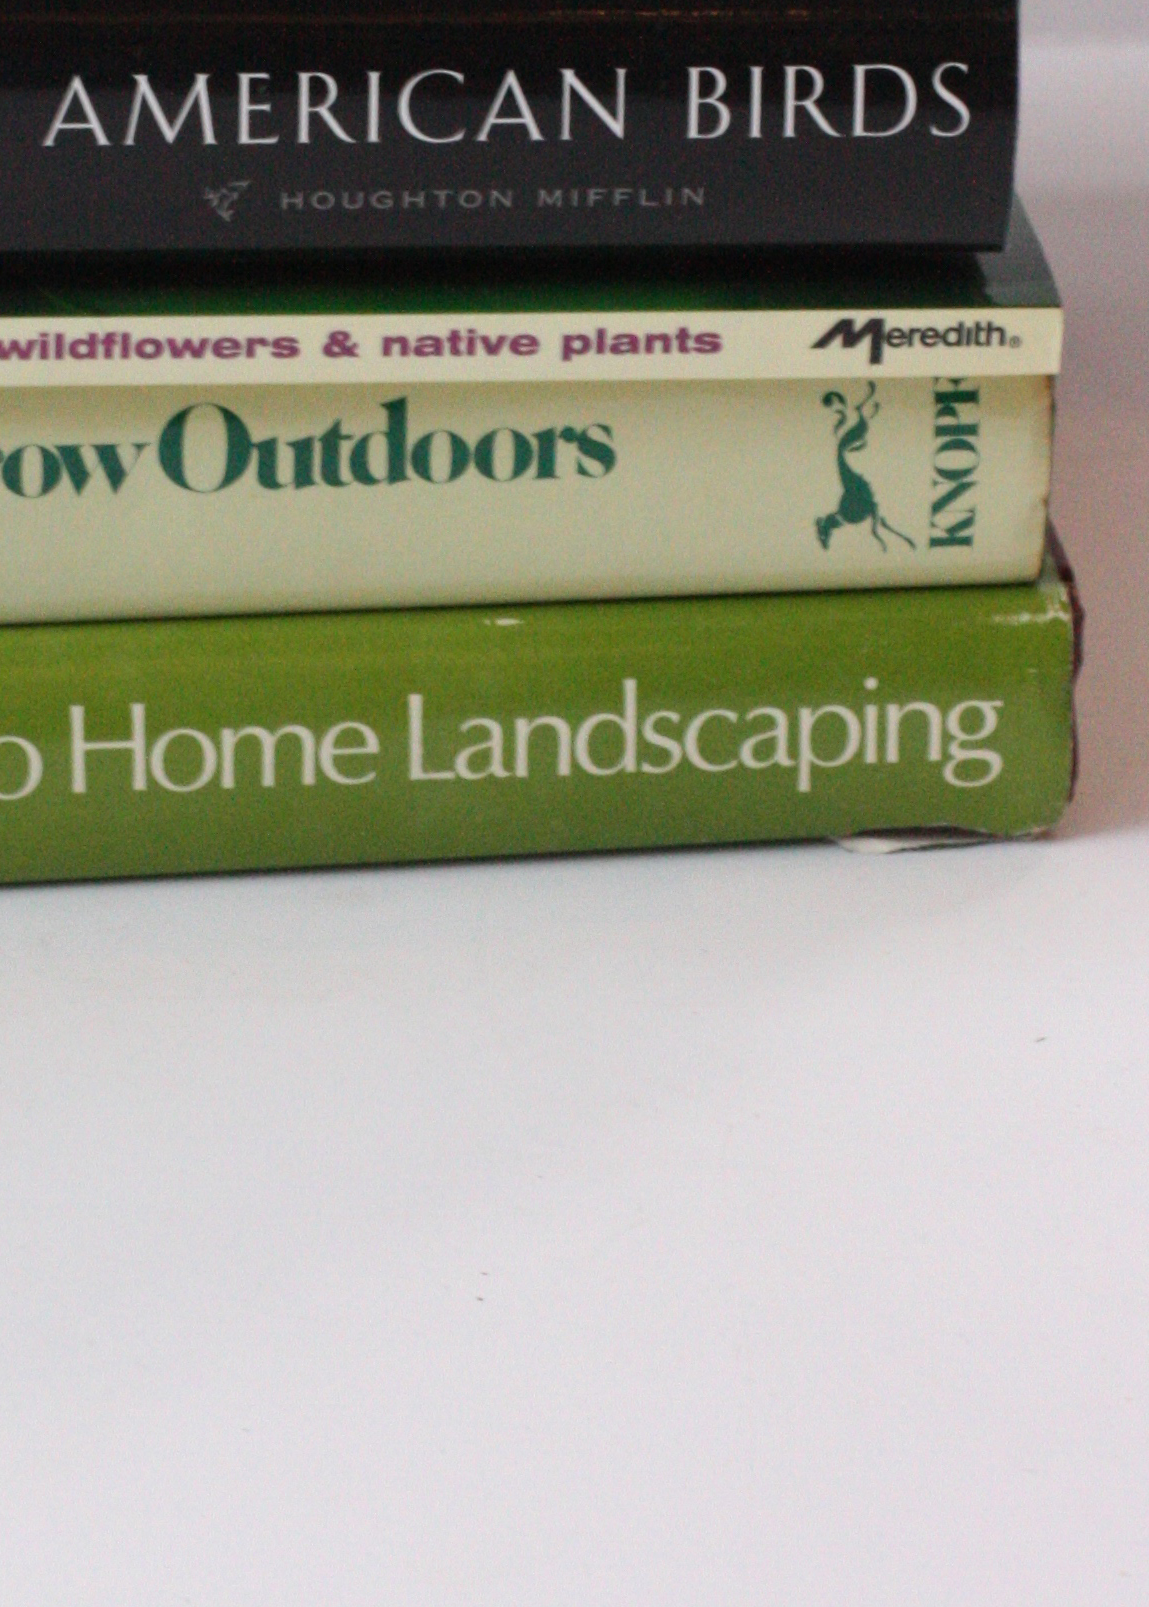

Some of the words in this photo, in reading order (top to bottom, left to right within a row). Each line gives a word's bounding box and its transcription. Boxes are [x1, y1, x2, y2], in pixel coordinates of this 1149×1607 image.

[42, 67, 629, 148] AMERICAN
[684, 61, 972, 140] BIRDS
[279, 189, 513, 213] HOUGHTON
[536, 187, 707, 208] MIFFLIN
[322, 329, 359, 359] &
[381, 327, 541, 358] native
[560, 326, 724, 362] plants
[158, 397, 616, 493] Outdoors
[69, 703, 380, 794] Home
[407, 677, 1004, 792] Landscaping
